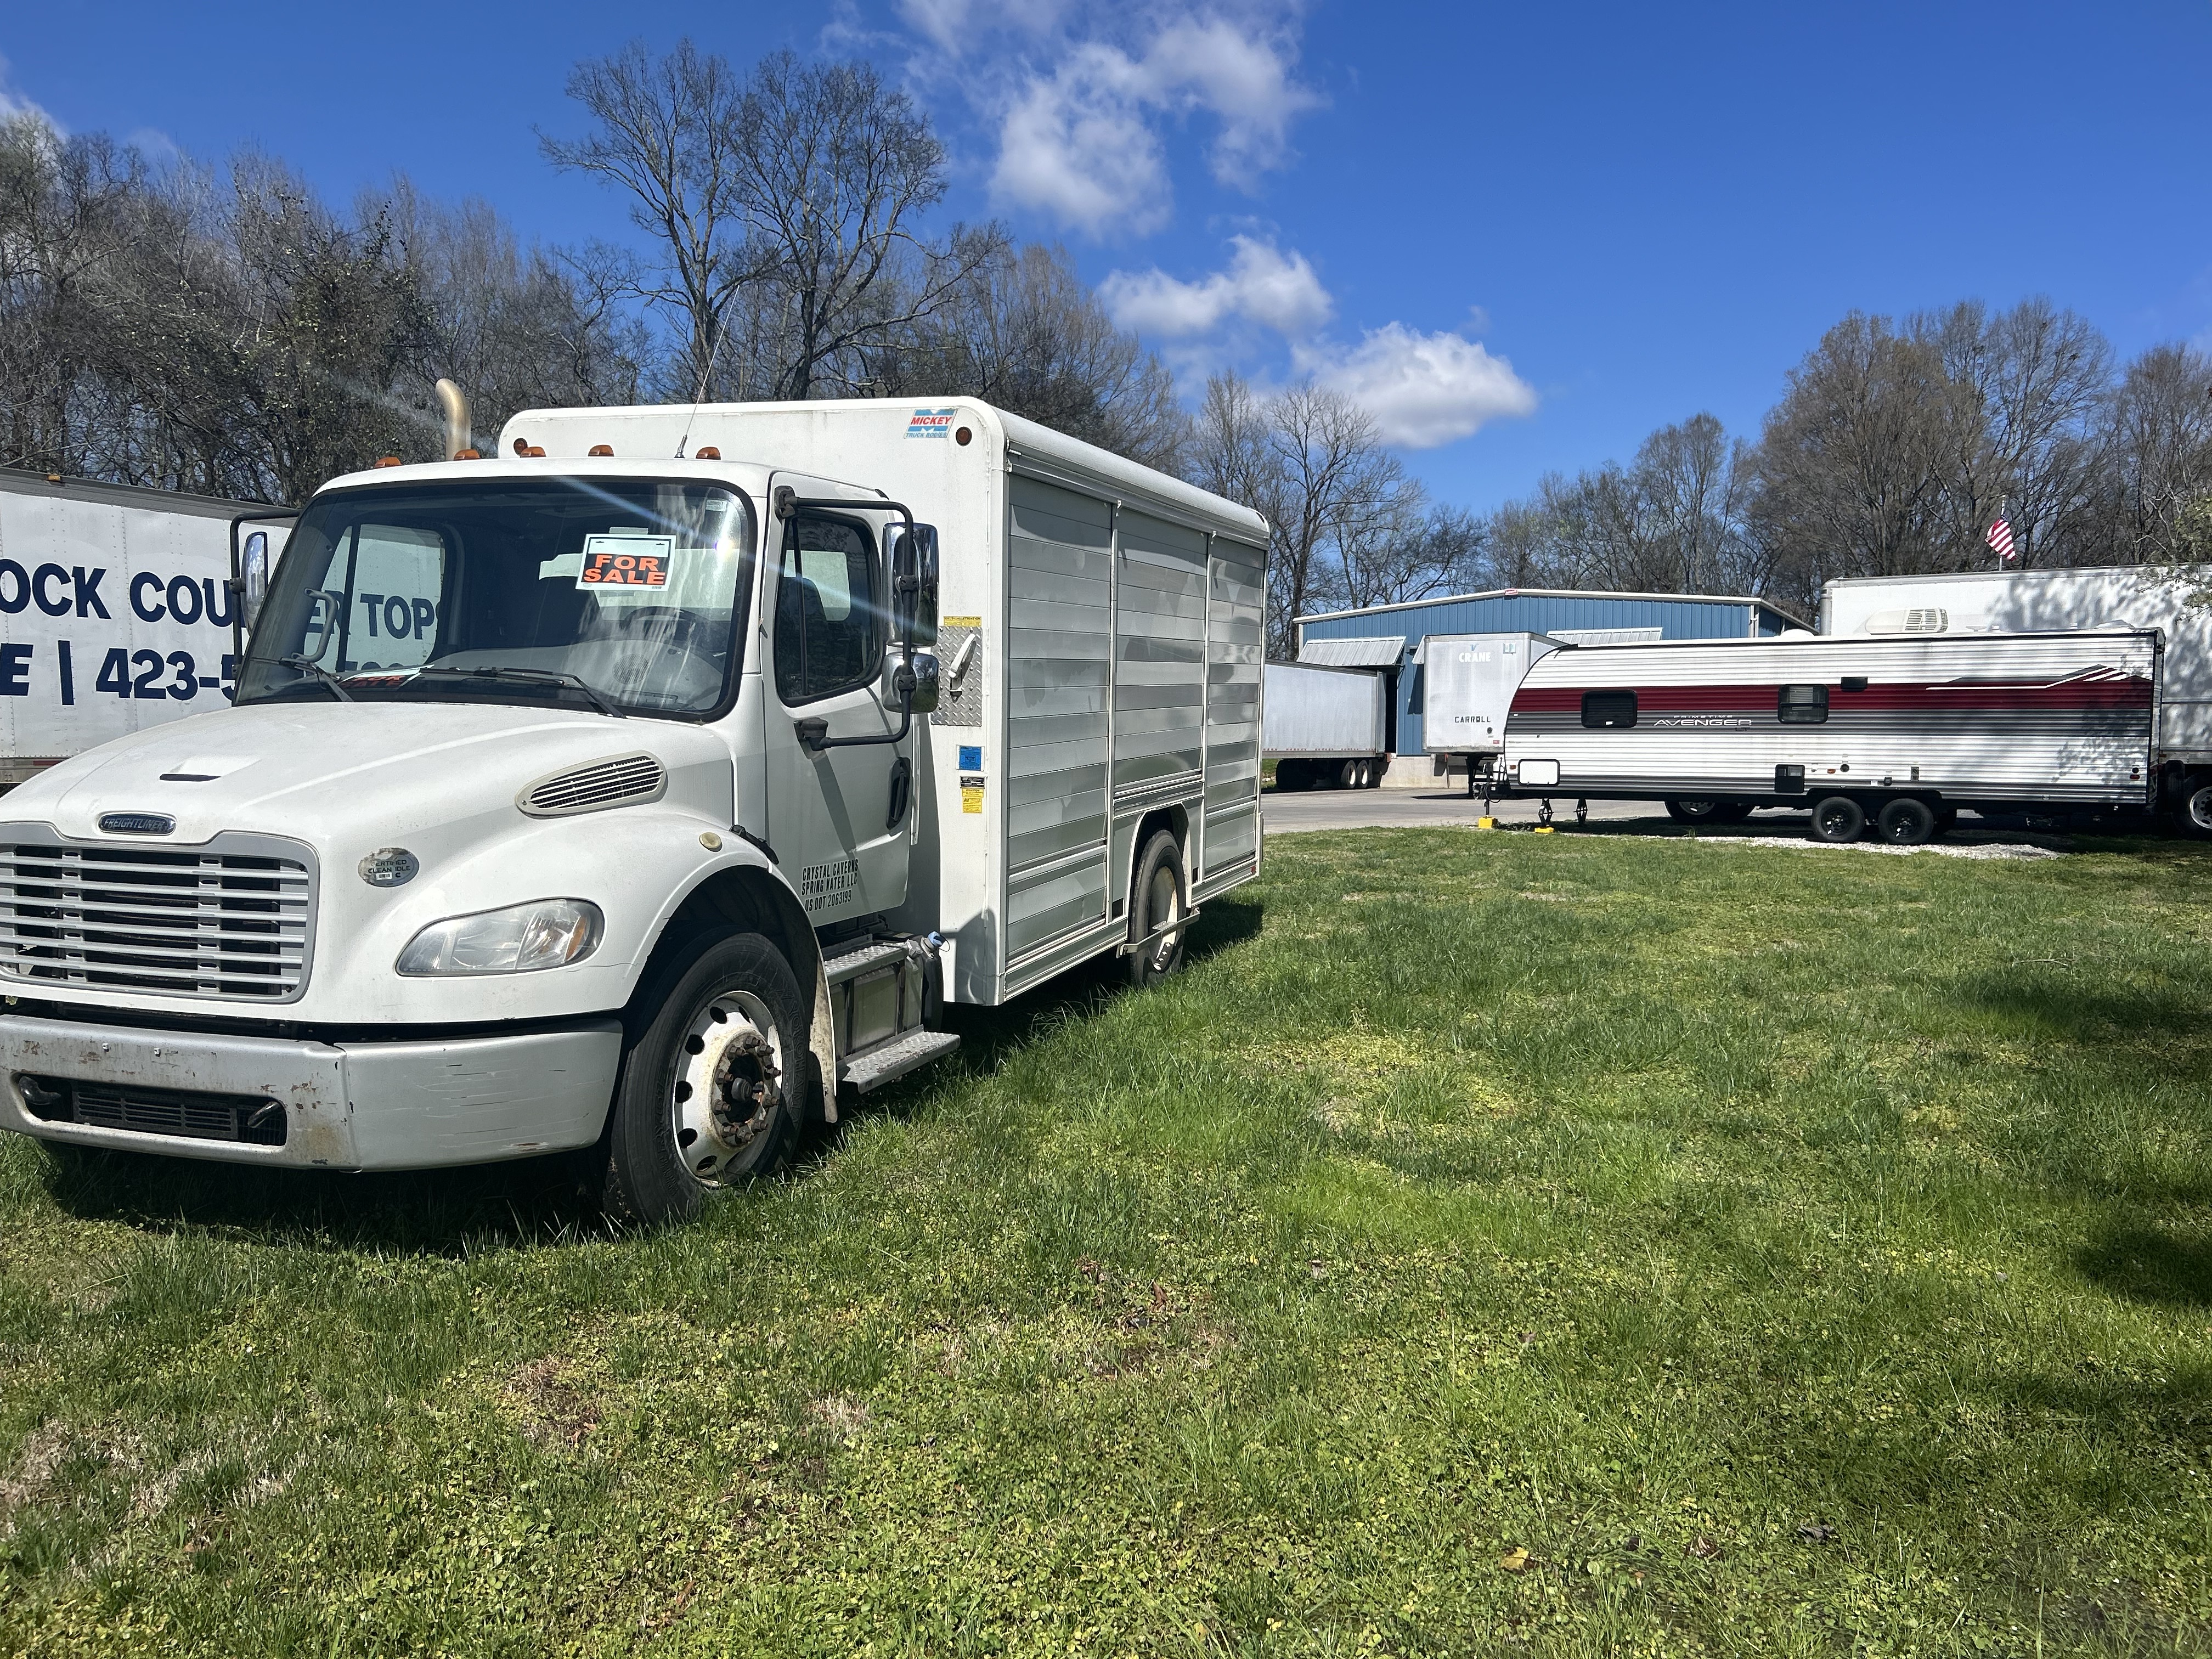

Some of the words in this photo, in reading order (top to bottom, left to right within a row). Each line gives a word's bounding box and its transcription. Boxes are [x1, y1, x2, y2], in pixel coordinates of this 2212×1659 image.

[595, 555, 658, 571] FOR
[583, 568, 665, 584] SALE
[1459, 652, 1491, 663] CRANE
[104, 817, 166, 831] FREIGHTLINER
[803, 865, 830, 881] CRYSTAL
[833, 859, 859, 876] CAVERNS
[802, 879, 824, 896] SPRING
[826, 875, 845, 891] WATER
[847, 872, 857, 887] LLC
[805, 899, 813, 912] US
[814, 895, 827, 911] DOT
[827, 889, 851, 907] 2063199
